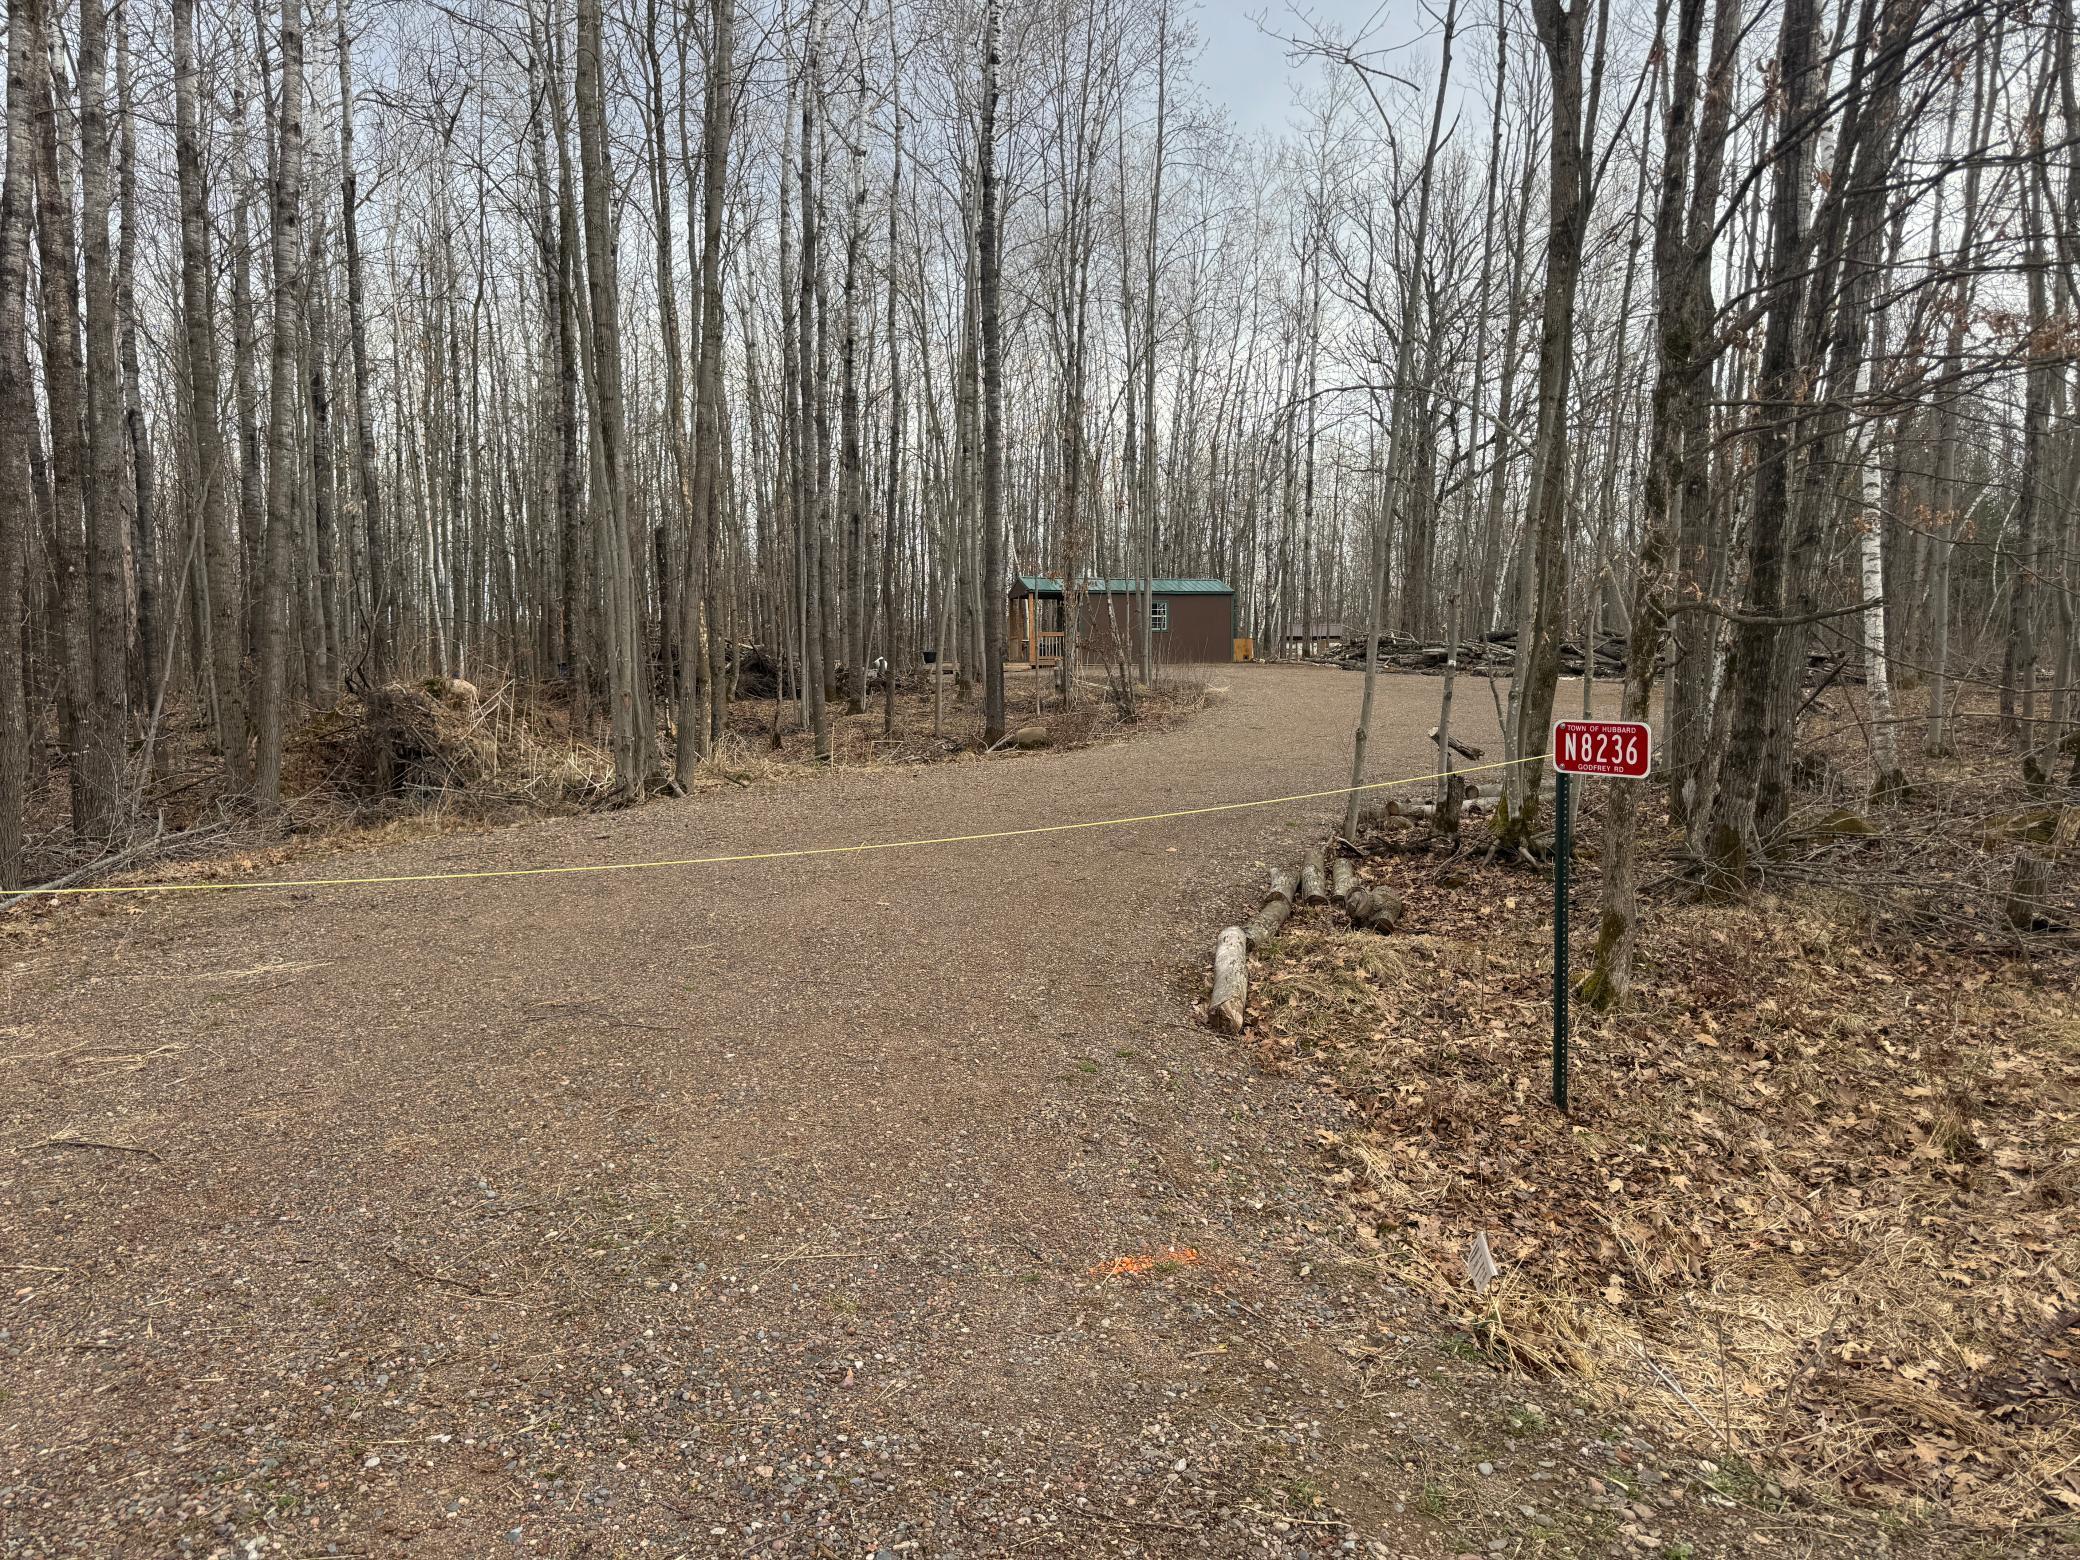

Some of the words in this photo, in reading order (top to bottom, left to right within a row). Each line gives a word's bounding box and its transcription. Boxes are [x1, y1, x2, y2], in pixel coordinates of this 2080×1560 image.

[1567, 724, 1587, 732] TOWN
[1602, 726, 1637, 734] HUBBARD
[1565, 732, 1638, 765] N8236
[1577, 763, 1611, 772] GODFREY
